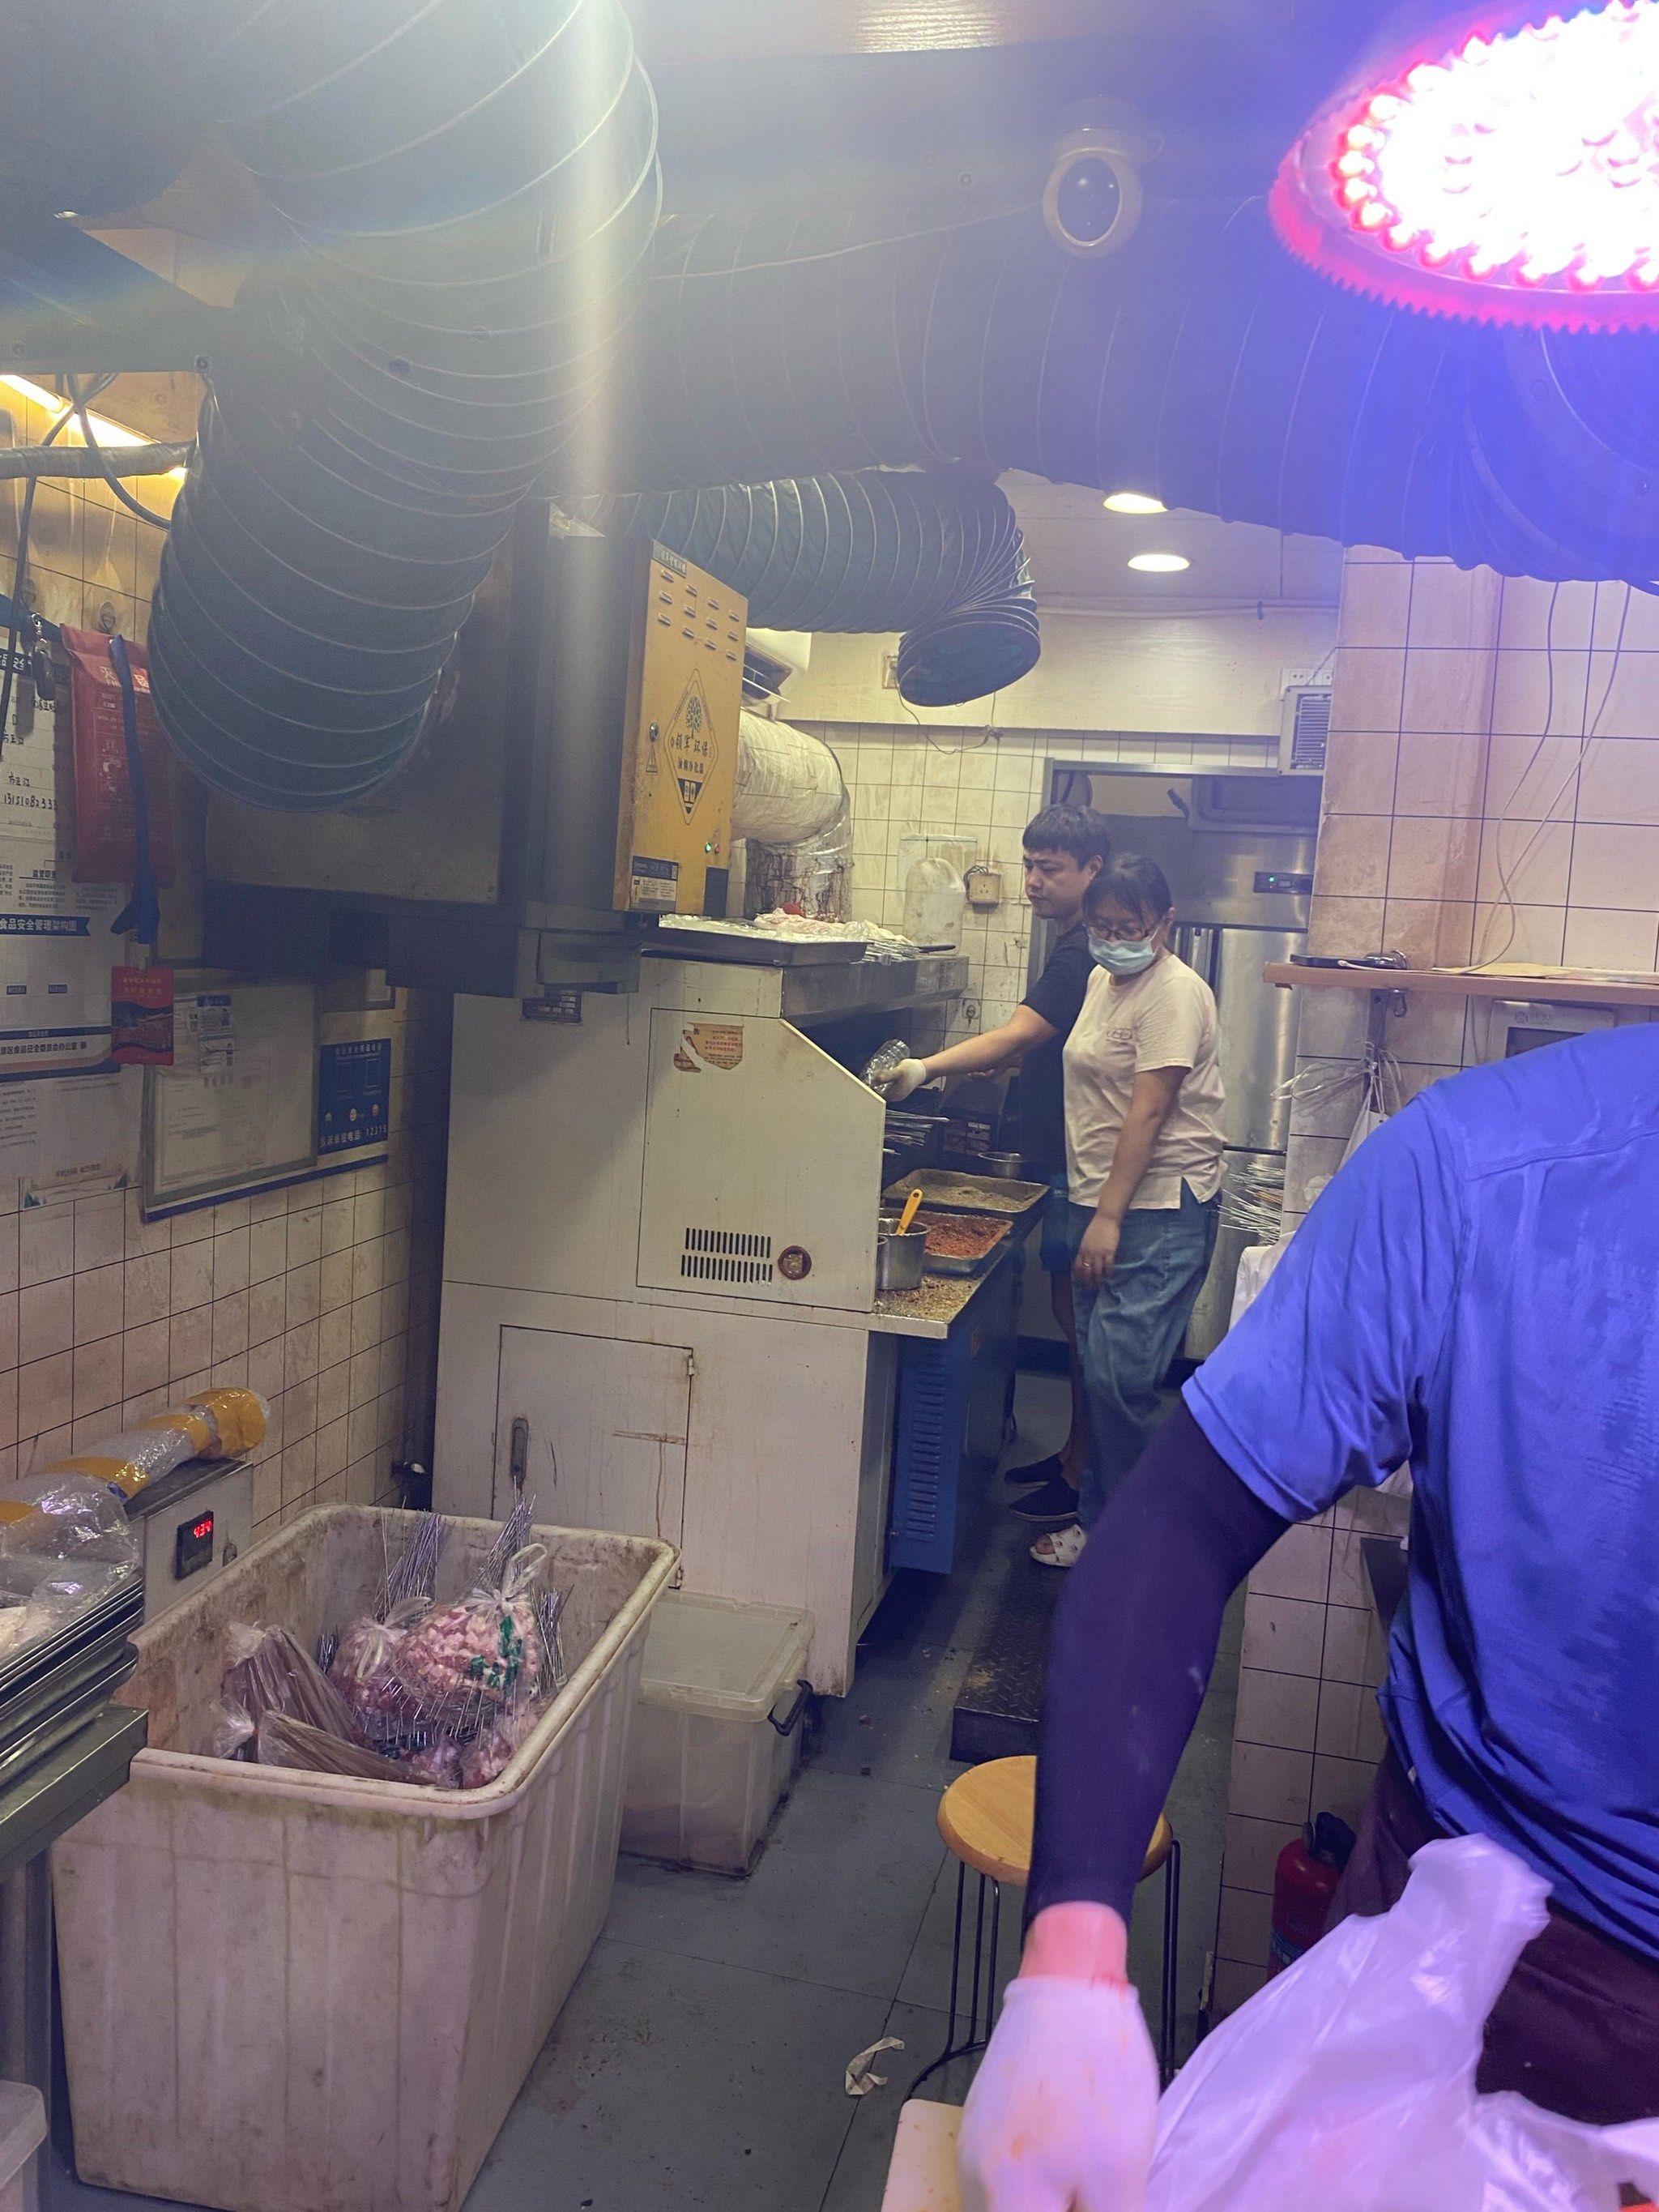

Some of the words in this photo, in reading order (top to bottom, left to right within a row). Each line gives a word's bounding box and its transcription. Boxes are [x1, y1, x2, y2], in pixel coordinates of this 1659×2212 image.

[677, 757, 704, 775] 油烟净化器
[366, 1124, 387, 1136] 12315
